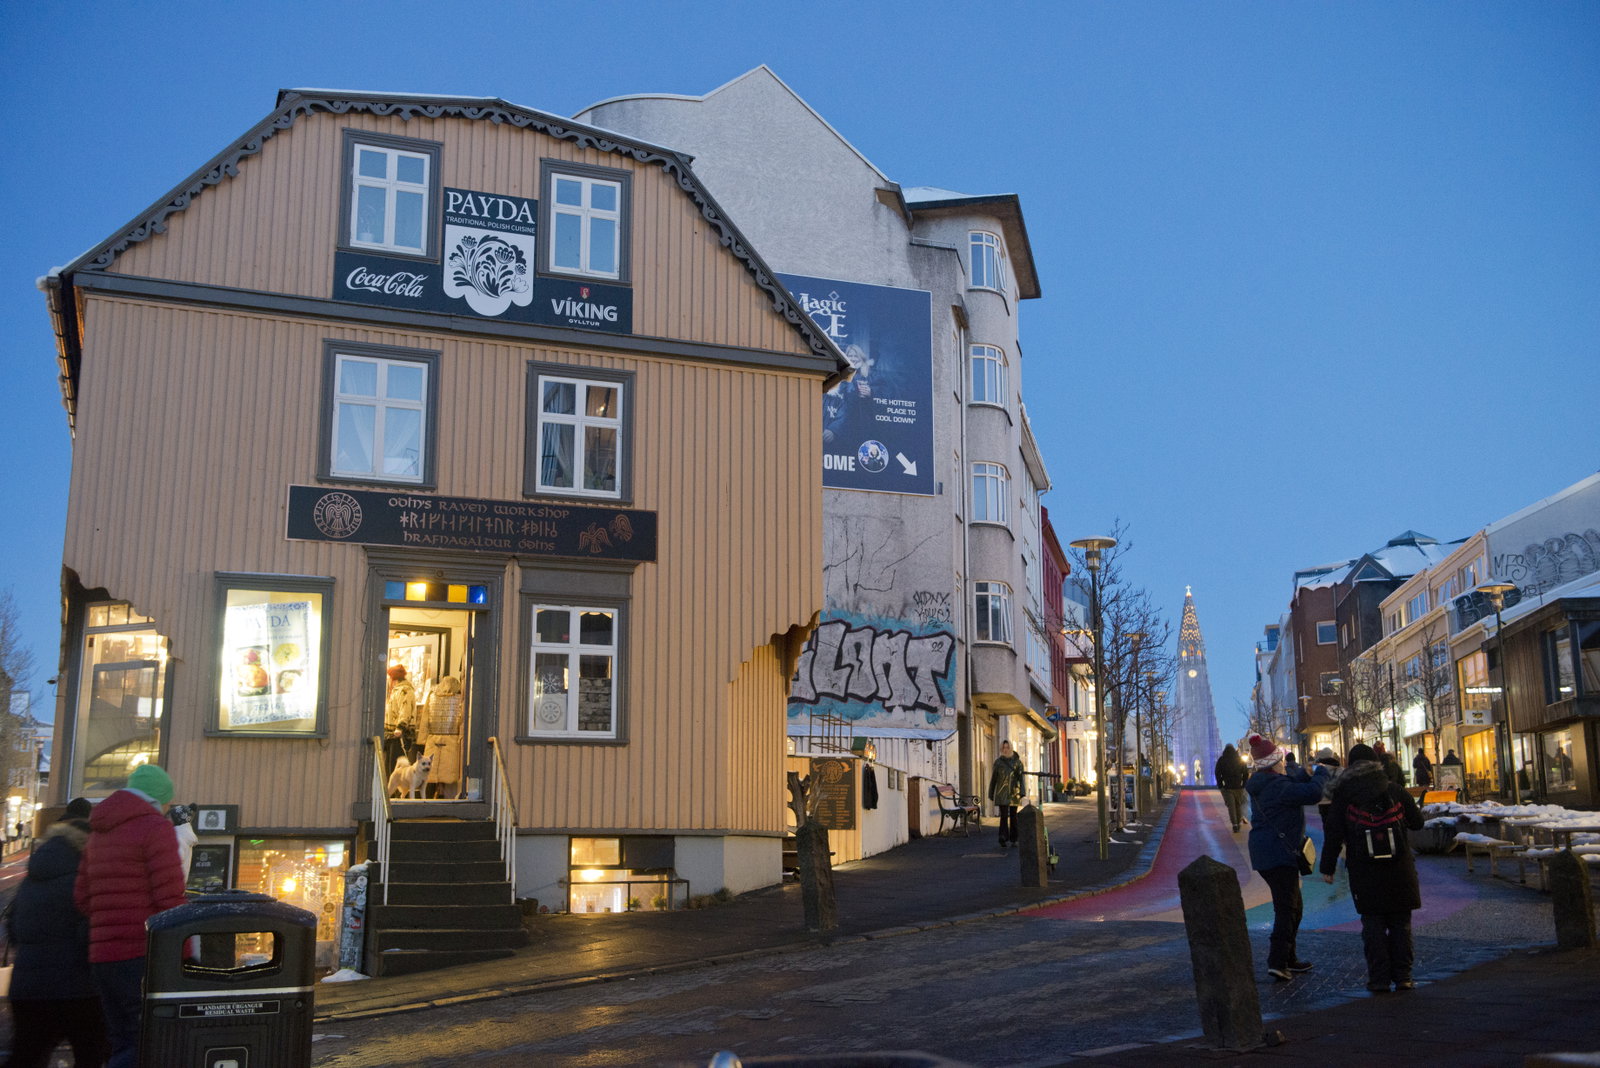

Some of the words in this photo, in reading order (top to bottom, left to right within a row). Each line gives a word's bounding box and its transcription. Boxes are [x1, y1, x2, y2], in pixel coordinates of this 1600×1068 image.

[446, 191, 536, 225] PAYDA
[446, 215, 487, 227] TRADITIONAL
[487, 221, 511, 231] POLISH
[510, 224, 536, 234] CUISINE
[346, 266, 429, 298] Coca-Cola
[550, 296, 618, 322] VÍKING
[568, 318, 600, 327] GYLLTUR
[888, 399, 916, 408] HOTTEST
[875, 414, 893, 422] COOL
[886, 407, 907, 415] PLACE
